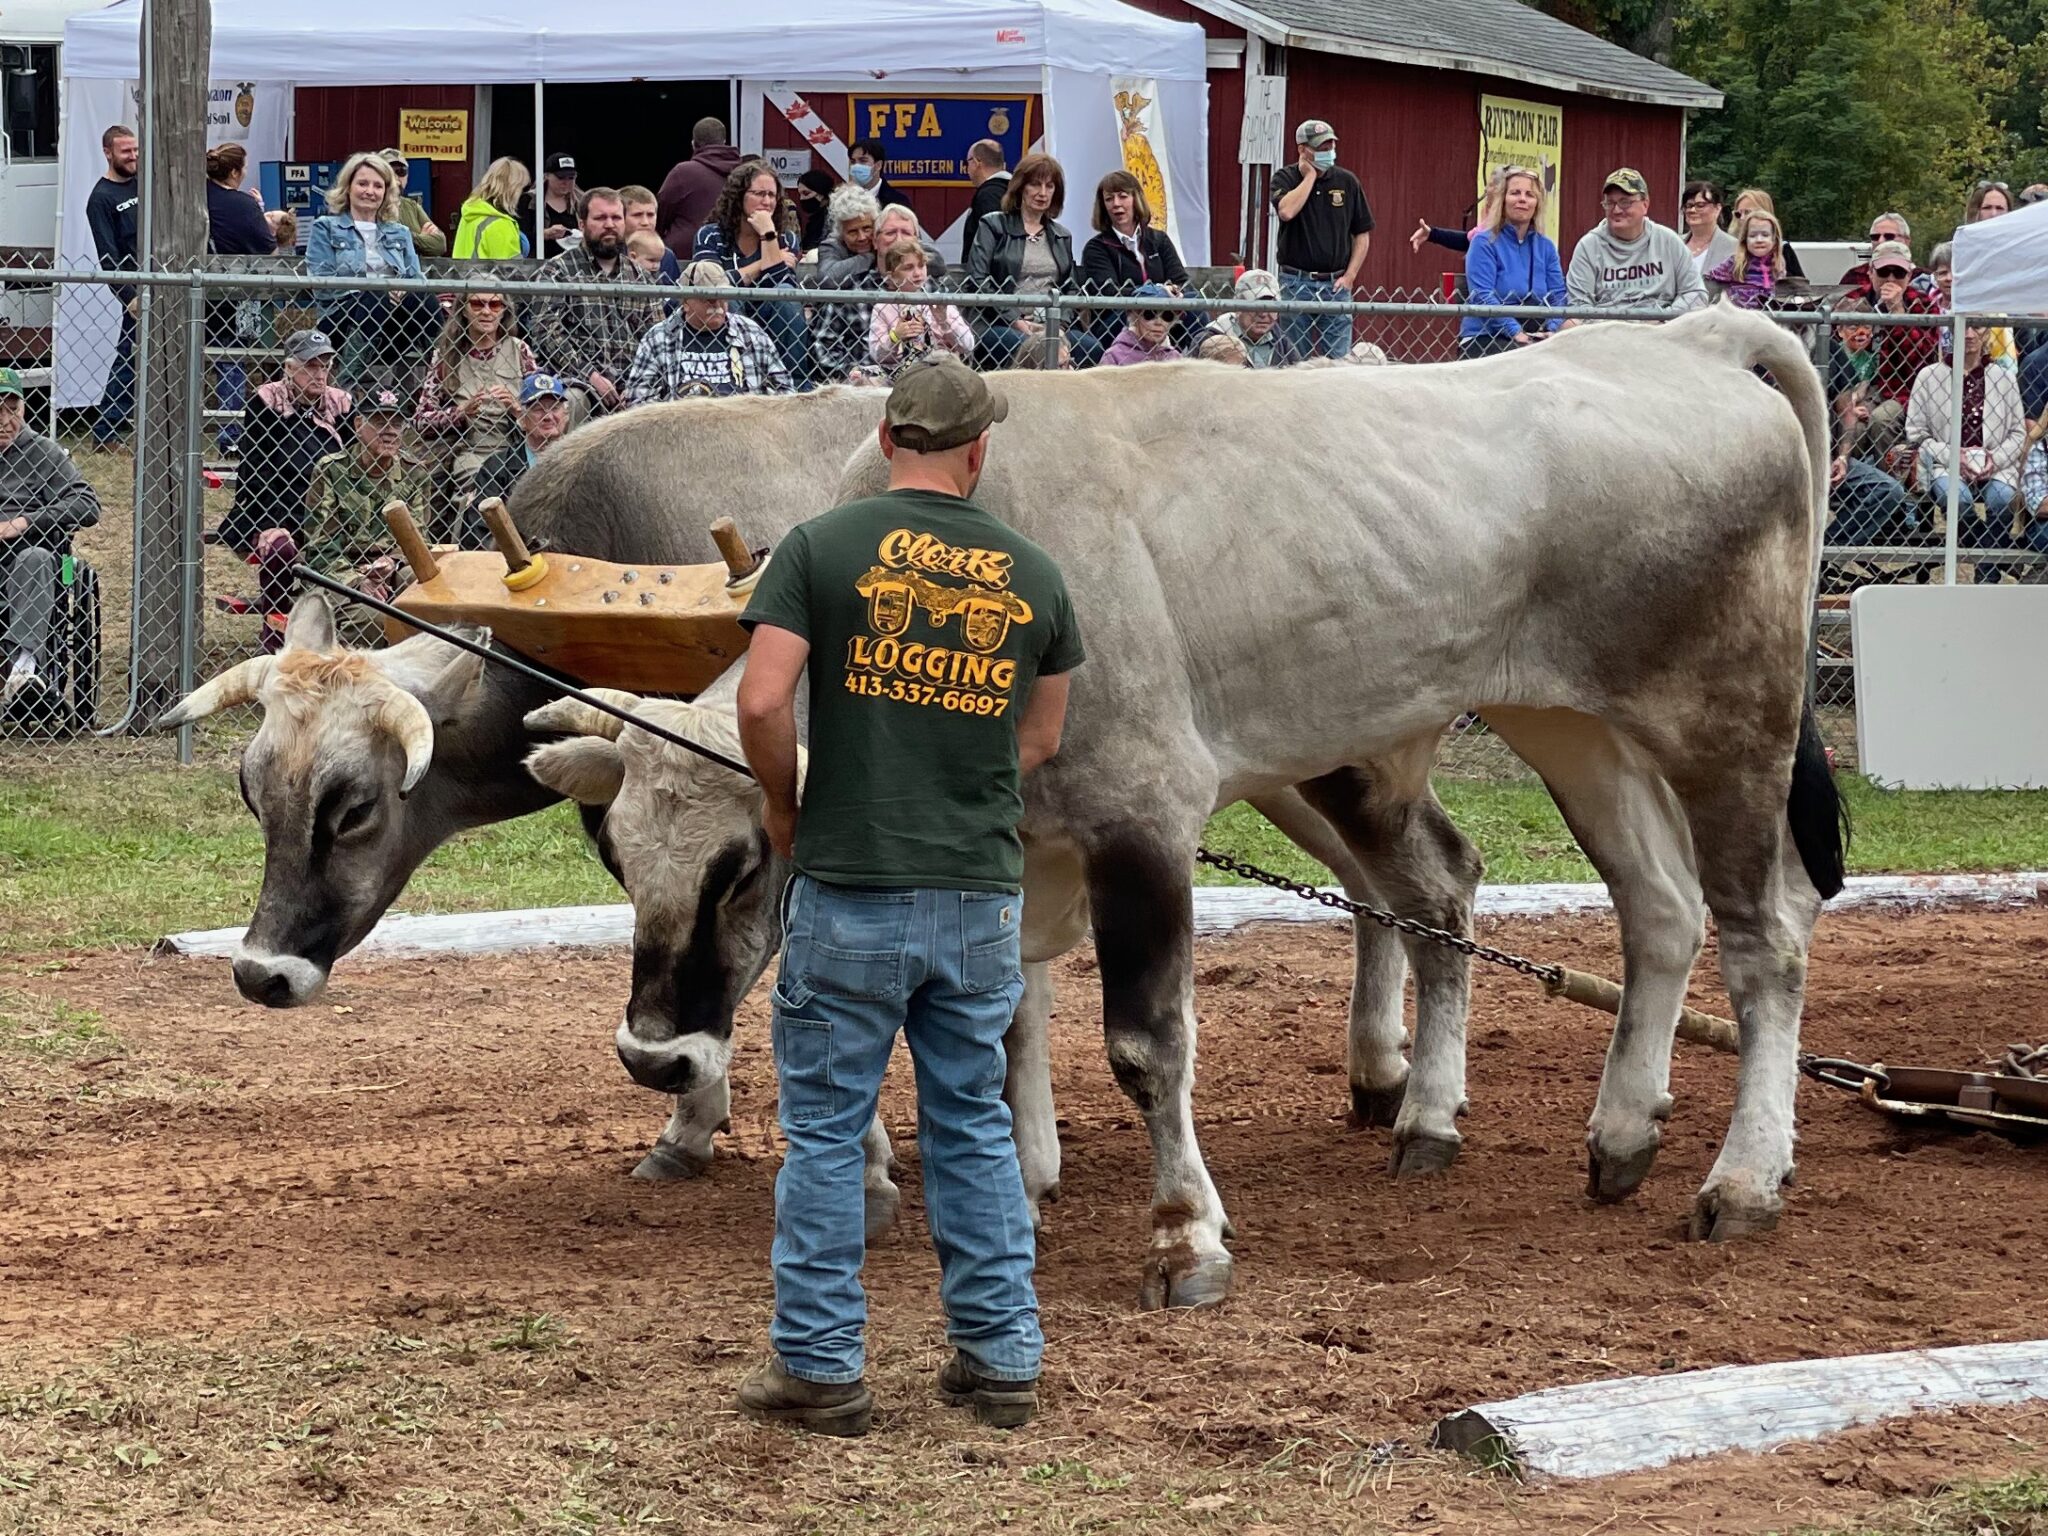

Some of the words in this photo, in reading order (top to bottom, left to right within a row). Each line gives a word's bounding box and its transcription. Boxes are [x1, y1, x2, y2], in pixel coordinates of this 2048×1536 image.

[408, 116, 460, 129] Welcome
[868, 103, 942, 138] FFA
[1485, 105, 1535, 143] RIVERTON
[1536, 114, 1558, 147] FAIR
[404, 143, 463, 154] Barnyard
[770, 157, 787, 169] NO
[883, 160, 953, 174] THWESTERN
[290, 170, 306, 178] FFA
[1604, 261, 1664, 282] UCONN
[681, 361, 730, 375] WALK
[845, 635, 1017, 696] LOGGING
[844, 671, 1009, 718] 413-337-6697
